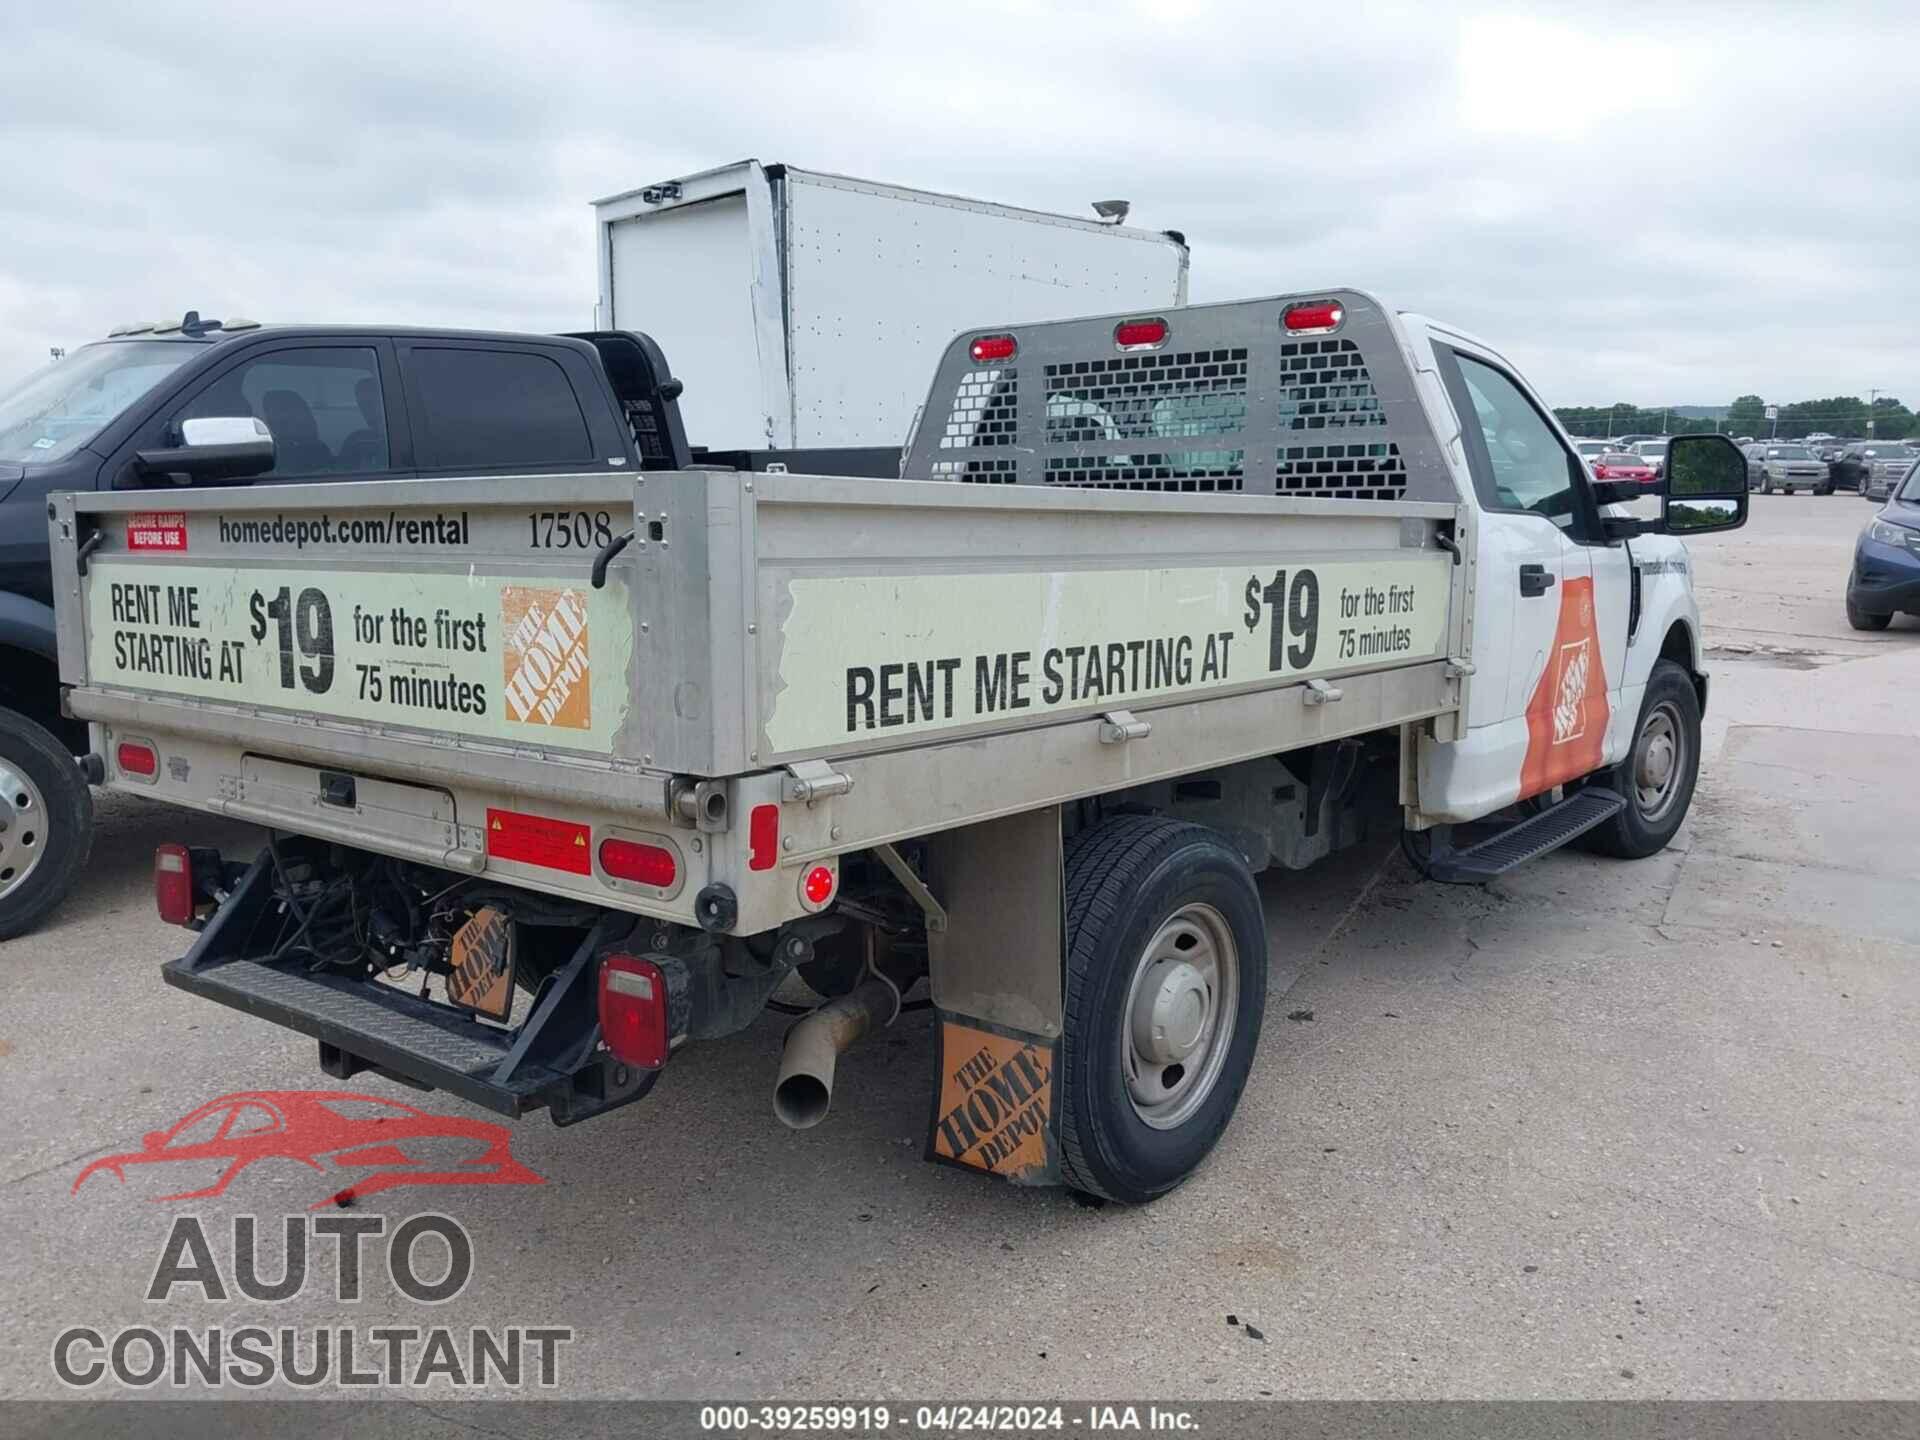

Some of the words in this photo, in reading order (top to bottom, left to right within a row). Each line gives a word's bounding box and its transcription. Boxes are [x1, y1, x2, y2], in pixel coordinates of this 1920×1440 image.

[134, 532, 162, 544] BEFORE
[165, 532, 180, 545] USE
[219, 512, 469, 549] homedepot.com/rental
[528, 511, 613, 549] 17508
[111, 583, 160, 625] RENT
[168, 586, 200, 628] ME
[1340, 587, 1361, 618] for
[1364, 586, 1385, 616] the
[1388, 584, 1415, 613] first
[250, 586, 335, 695] $19
[353, 604, 384, 643] for
[390, 607, 427, 648] the
[434, 608, 487, 652] first
[510, 600, 546, 657] THE
[846, 657, 961, 732] RENT
[974, 650, 1031, 714] ME
[1042, 636, 1192, 704] STARTING
[1200, 631, 1234, 681] AT
[1244, 569, 1319, 672] $19
[1338, 629, 1356, 659] 75
[1359, 623, 1411, 656] minutes
[114, 630, 212, 680] STARTING
[219, 640, 245, 684] AT
[504, 588, 588, 723] HOME
[356, 664, 382, 702] 75
[390, 667, 487, 715] minutes
[537, 641, 593, 726] DEPOT
[449, 914, 505, 1002] HOM
[953, 1046, 998, 1091] THE
[938, 1044, 1051, 1157] HOME
[978, 1097, 1048, 1169] DEPOT
